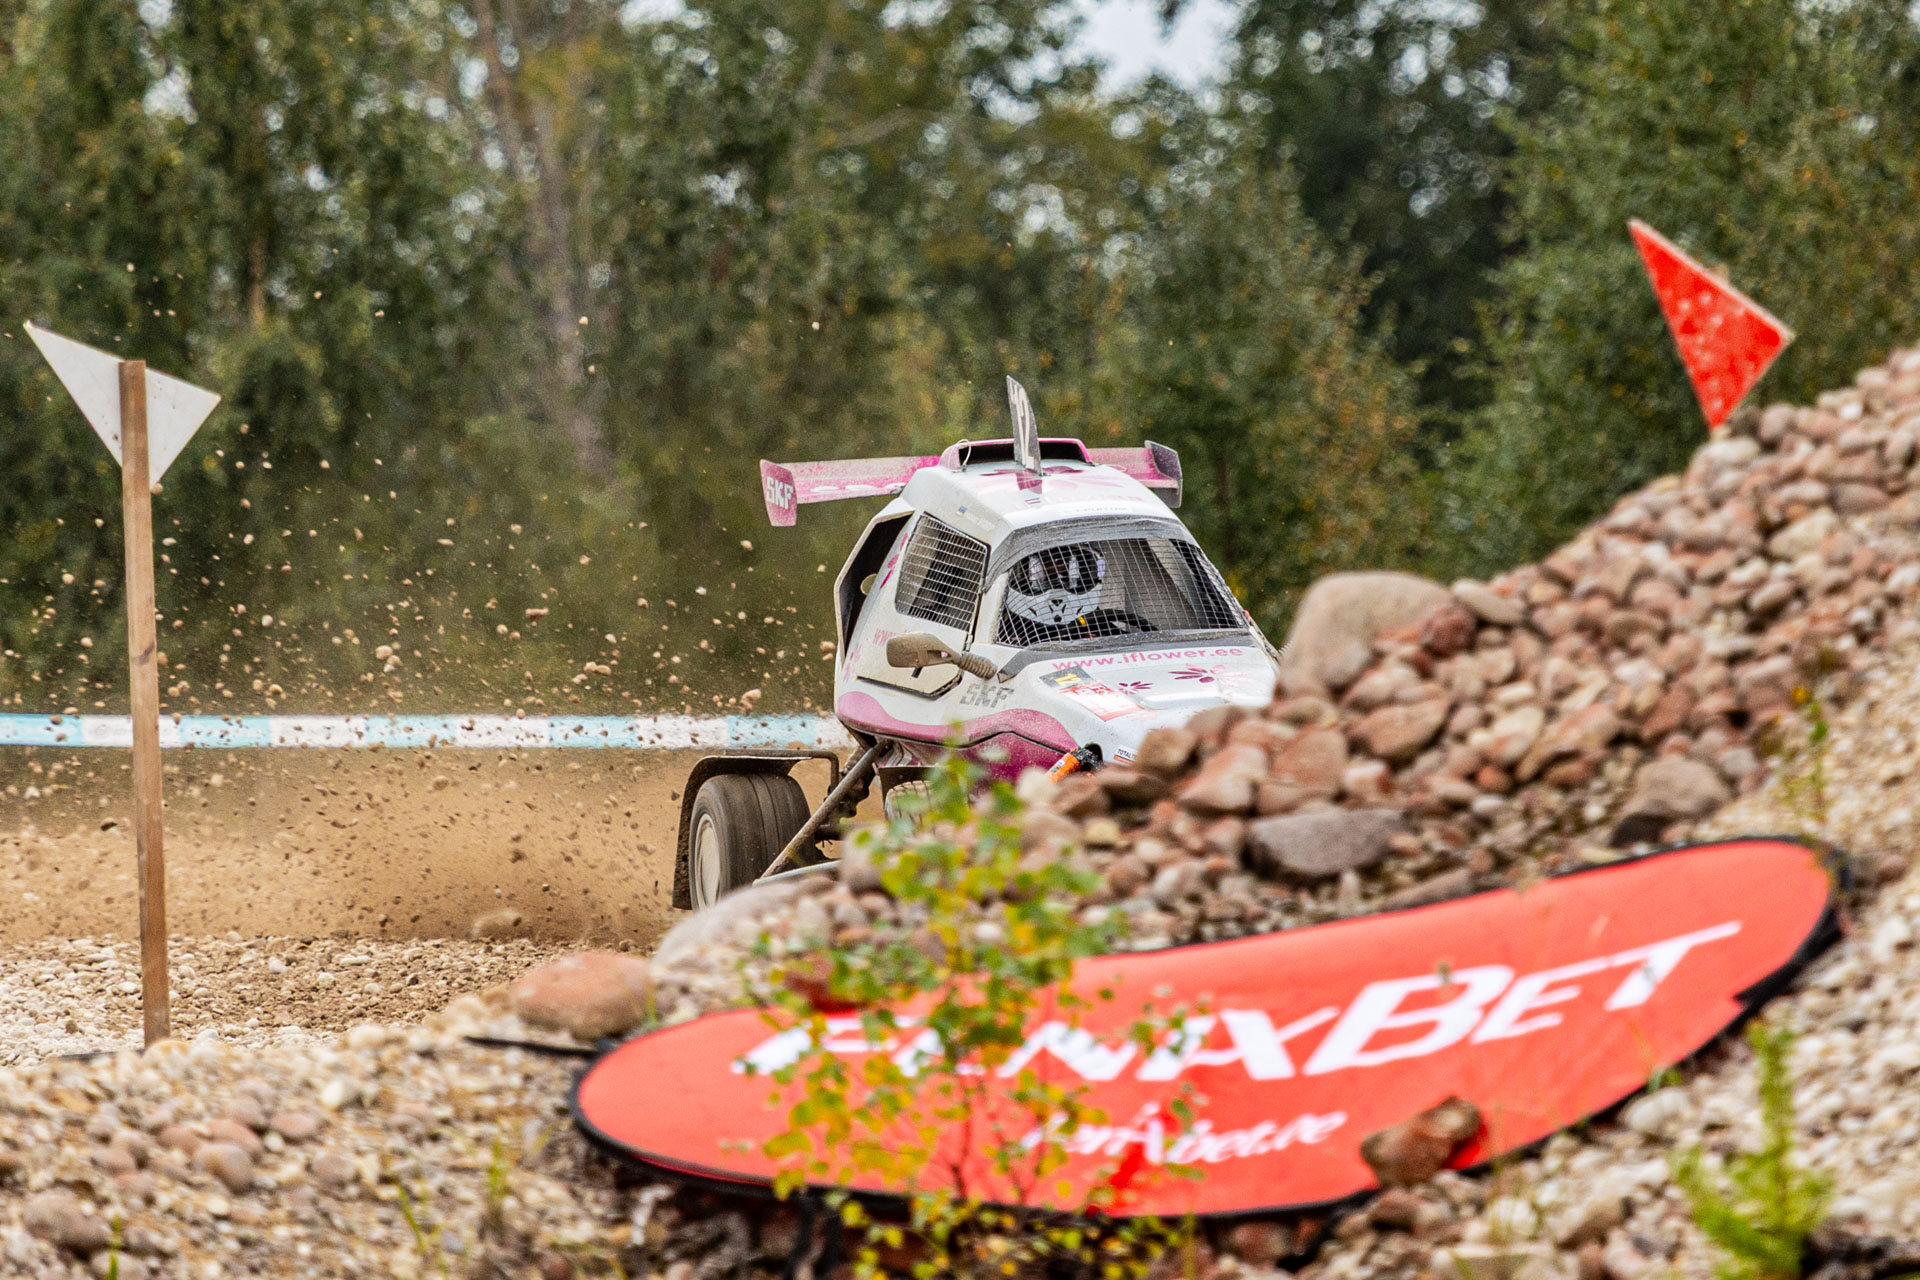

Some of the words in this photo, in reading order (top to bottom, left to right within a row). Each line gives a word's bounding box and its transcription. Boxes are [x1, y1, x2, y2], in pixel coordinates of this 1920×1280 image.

[766, 477, 794, 509] SKF
[1052, 648, 1243, 670] www.iflower.ee
[960, 683, 1015, 708] SKF
